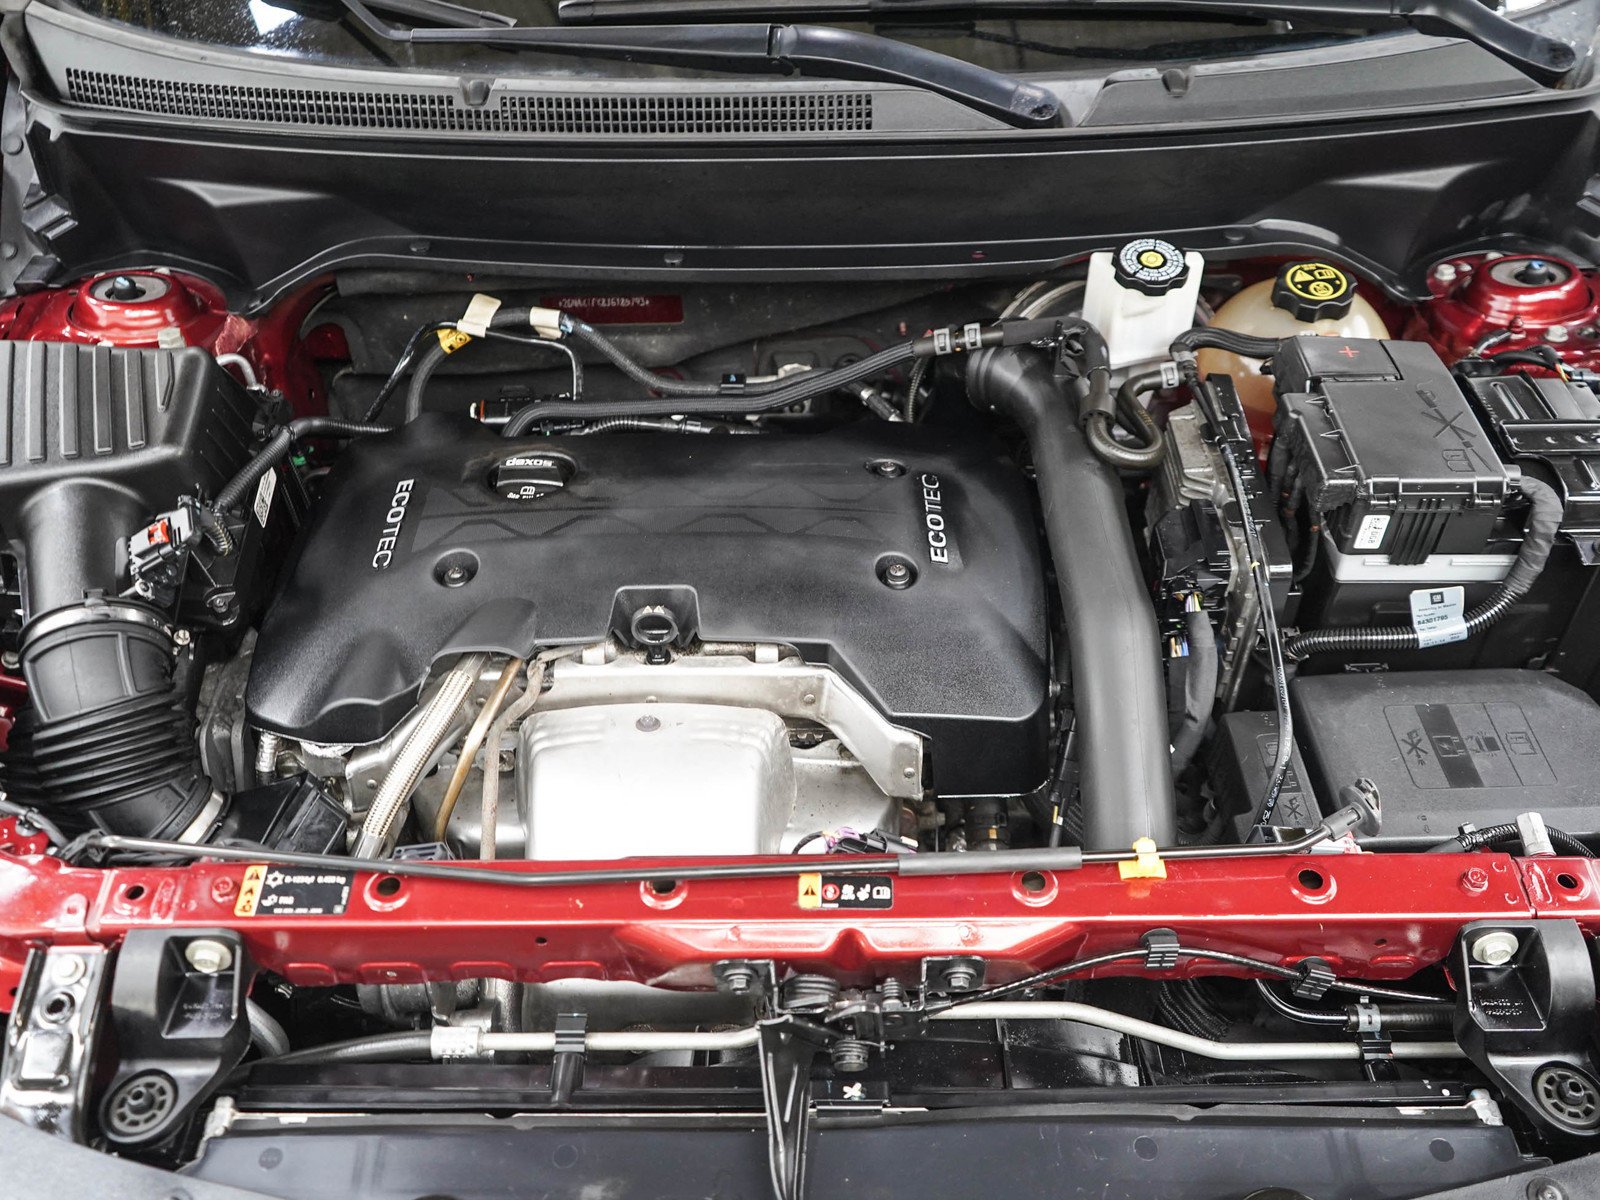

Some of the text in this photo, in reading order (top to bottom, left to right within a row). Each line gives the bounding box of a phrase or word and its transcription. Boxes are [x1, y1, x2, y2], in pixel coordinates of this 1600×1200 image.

[505, 457, 553, 467] dexos
[372, 478, 415, 569] ECOTEC
[922, 474, 948, 563] ECOTEC
